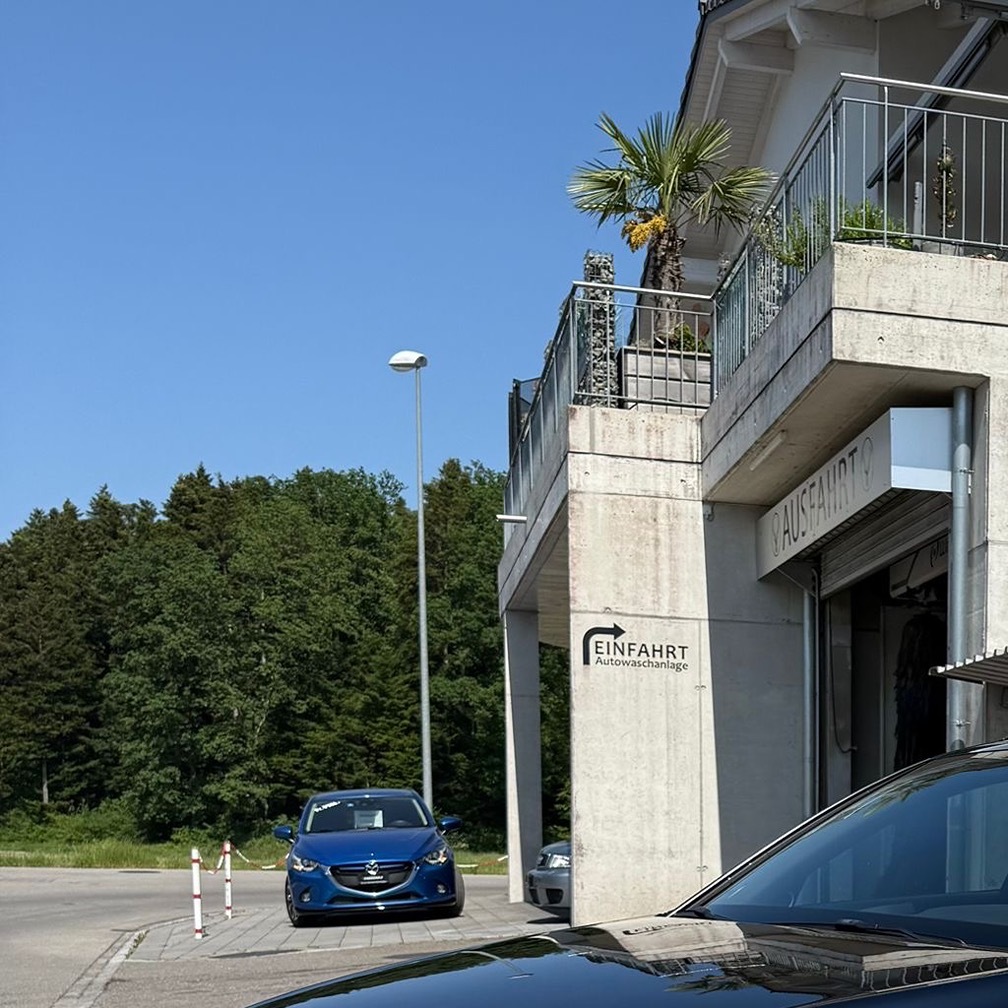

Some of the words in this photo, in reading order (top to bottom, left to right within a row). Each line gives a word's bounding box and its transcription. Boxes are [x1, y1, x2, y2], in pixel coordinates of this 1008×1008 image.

[782, 446, 858, 551] AUSFAHRT
[594, 640, 689, 660] EINFAHRT
[595, 656, 689, 672] Autowaschanlage
